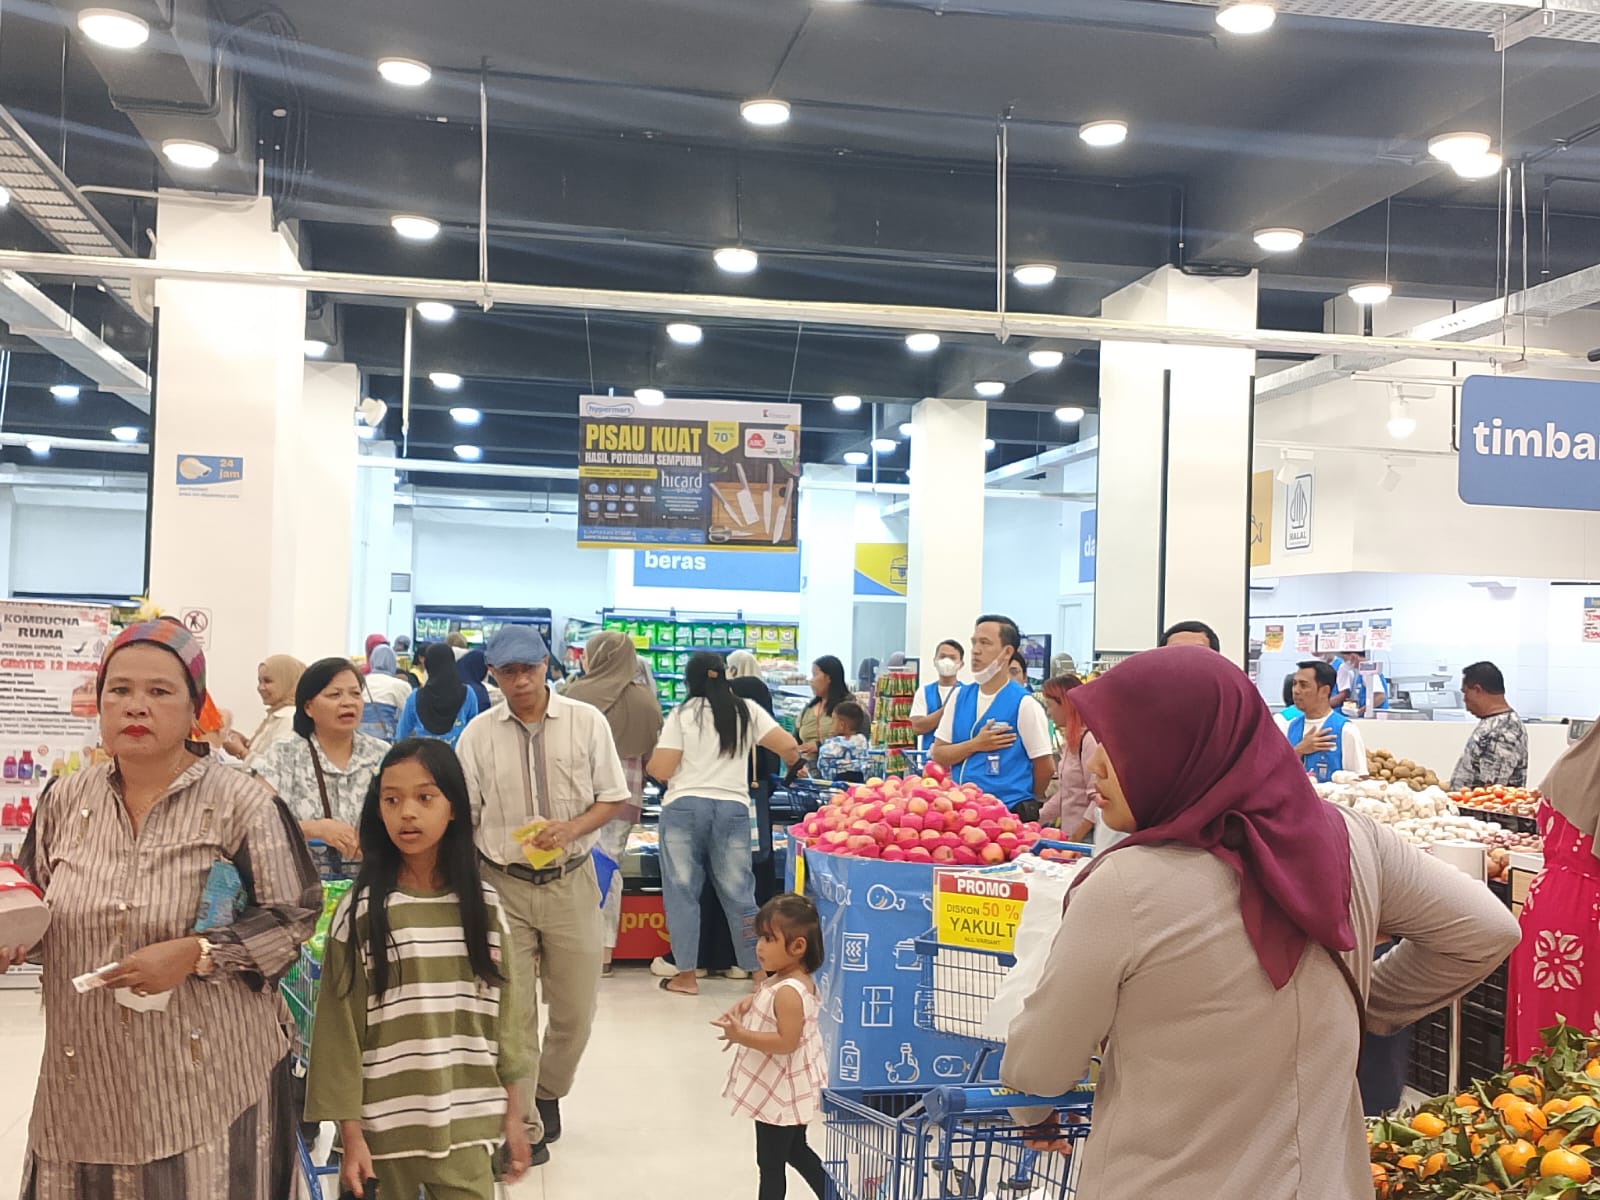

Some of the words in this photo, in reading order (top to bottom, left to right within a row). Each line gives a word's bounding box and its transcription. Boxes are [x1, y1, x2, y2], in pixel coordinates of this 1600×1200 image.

[585, 423, 645, 451] PISAU
[651, 426, 702, 453] KUAT
[1472, 418, 1600, 460] timba
[585, 452, 609, 464] HASIL
[611, 453, 654, 465] POTONGAN
[656, 454, 702, 466] SEMPURNA
[219, 468, 240, 479] jam
[661, 469, 702, 489] hicard
[1289, 531, 1307, 541] HALAL
[645, 551, 706, 570] beras
[4, 613, 80, 626] KOMBUCHA
[18, 627, 64, 639] RUMA
[1, 658, 46, 671] GRATIS
[957, 879, 1011, 898] PROMO
[947, 904, 980, 915] DISKON
[982, 902, 999, 917] 50
[1005, 904, 1019, 920] %
[950, 917, 1016, 938] YAKULT
